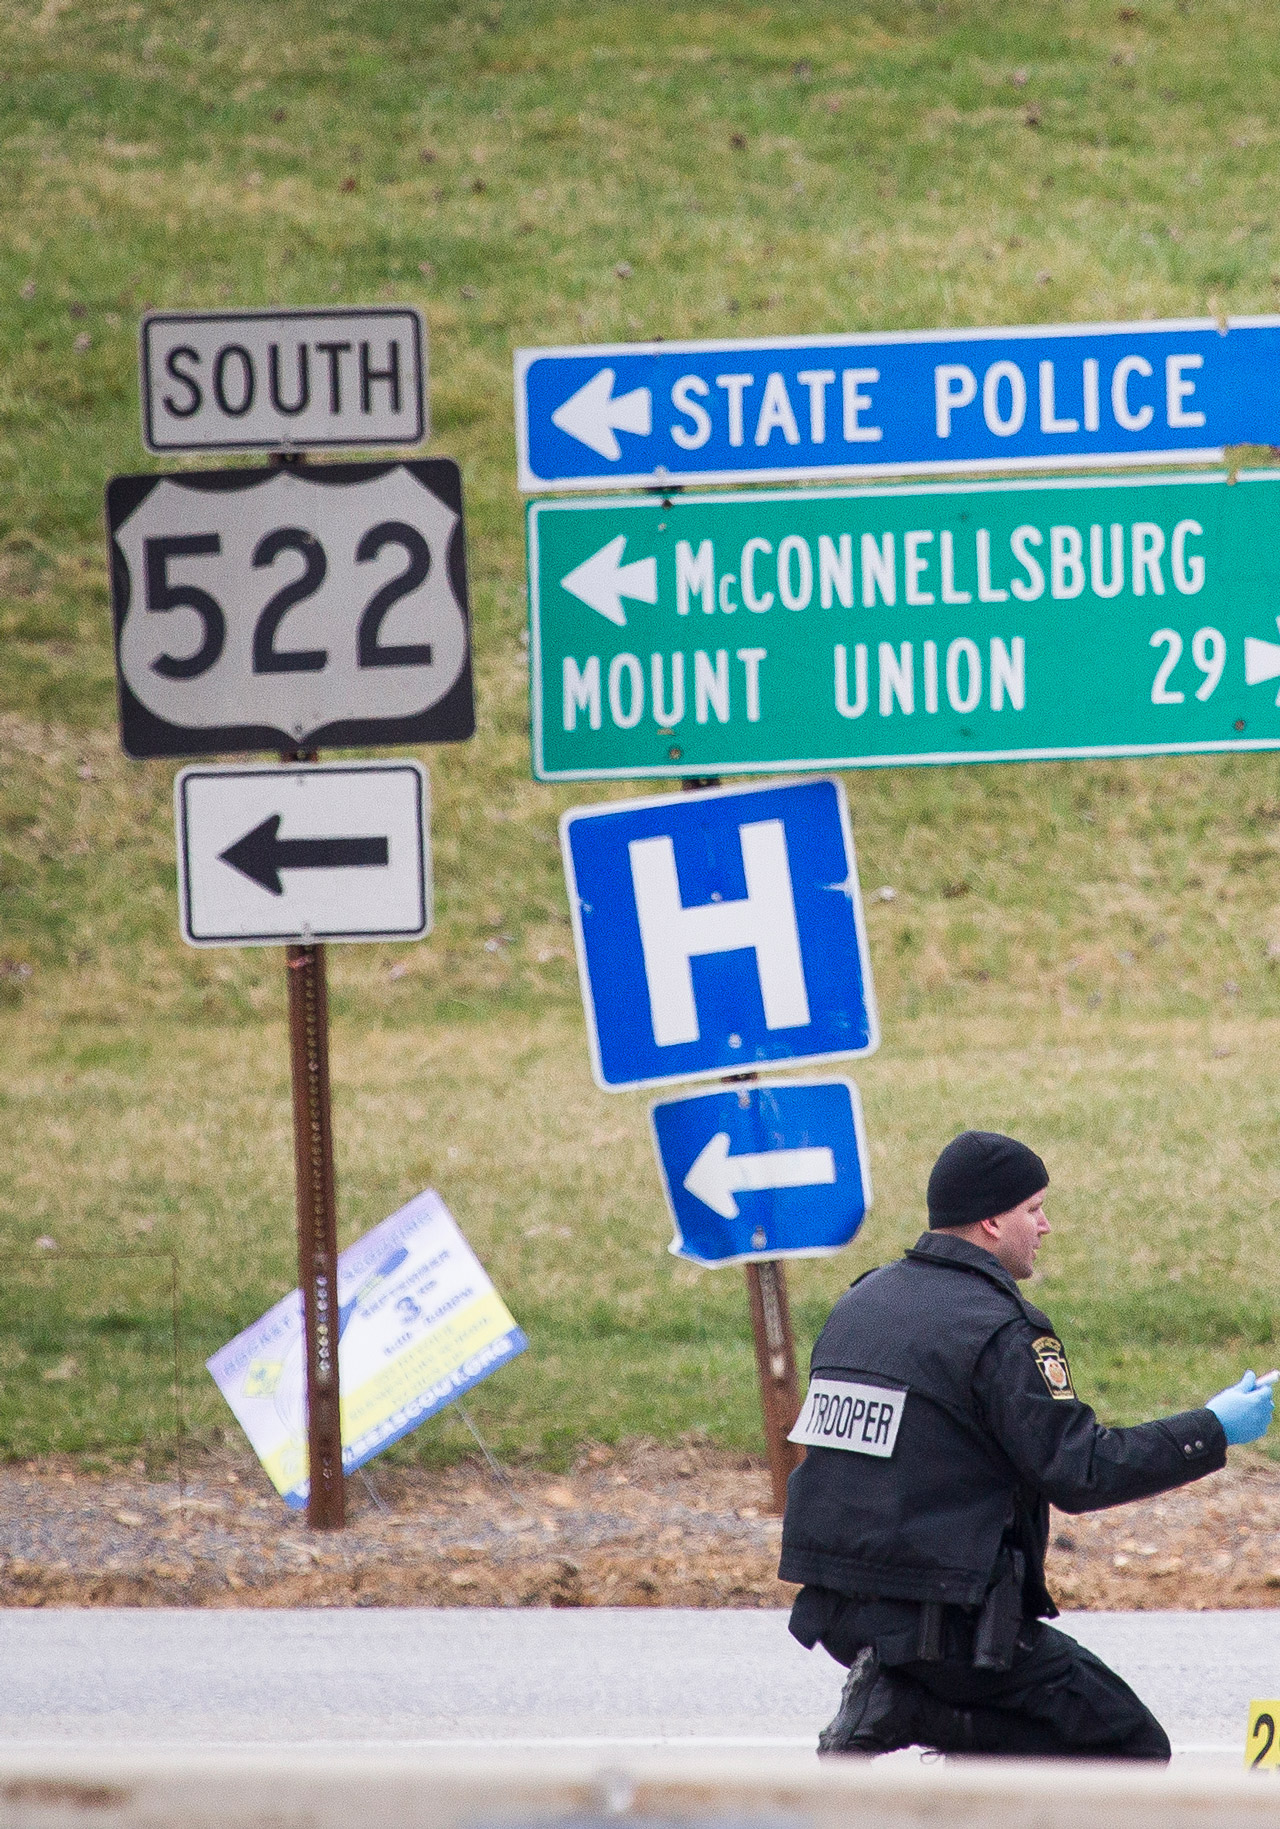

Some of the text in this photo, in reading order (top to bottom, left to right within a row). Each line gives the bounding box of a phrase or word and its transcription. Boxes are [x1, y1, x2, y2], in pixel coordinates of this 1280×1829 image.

[162, 339, 402, 419] SOUTH
[671, 354, 1205, 449] STATE POLICE
[143, 521, 433, 681] 522
[676, 519, 1205, 615] McCONNELLSBURG
[563, 627, 1226, 730] MOUNT UNION 29
[629, 819, 810, 1046] H
[394, 1295, 422, 1325] 3
[806, 1393, 894, 1445] TROOPER
